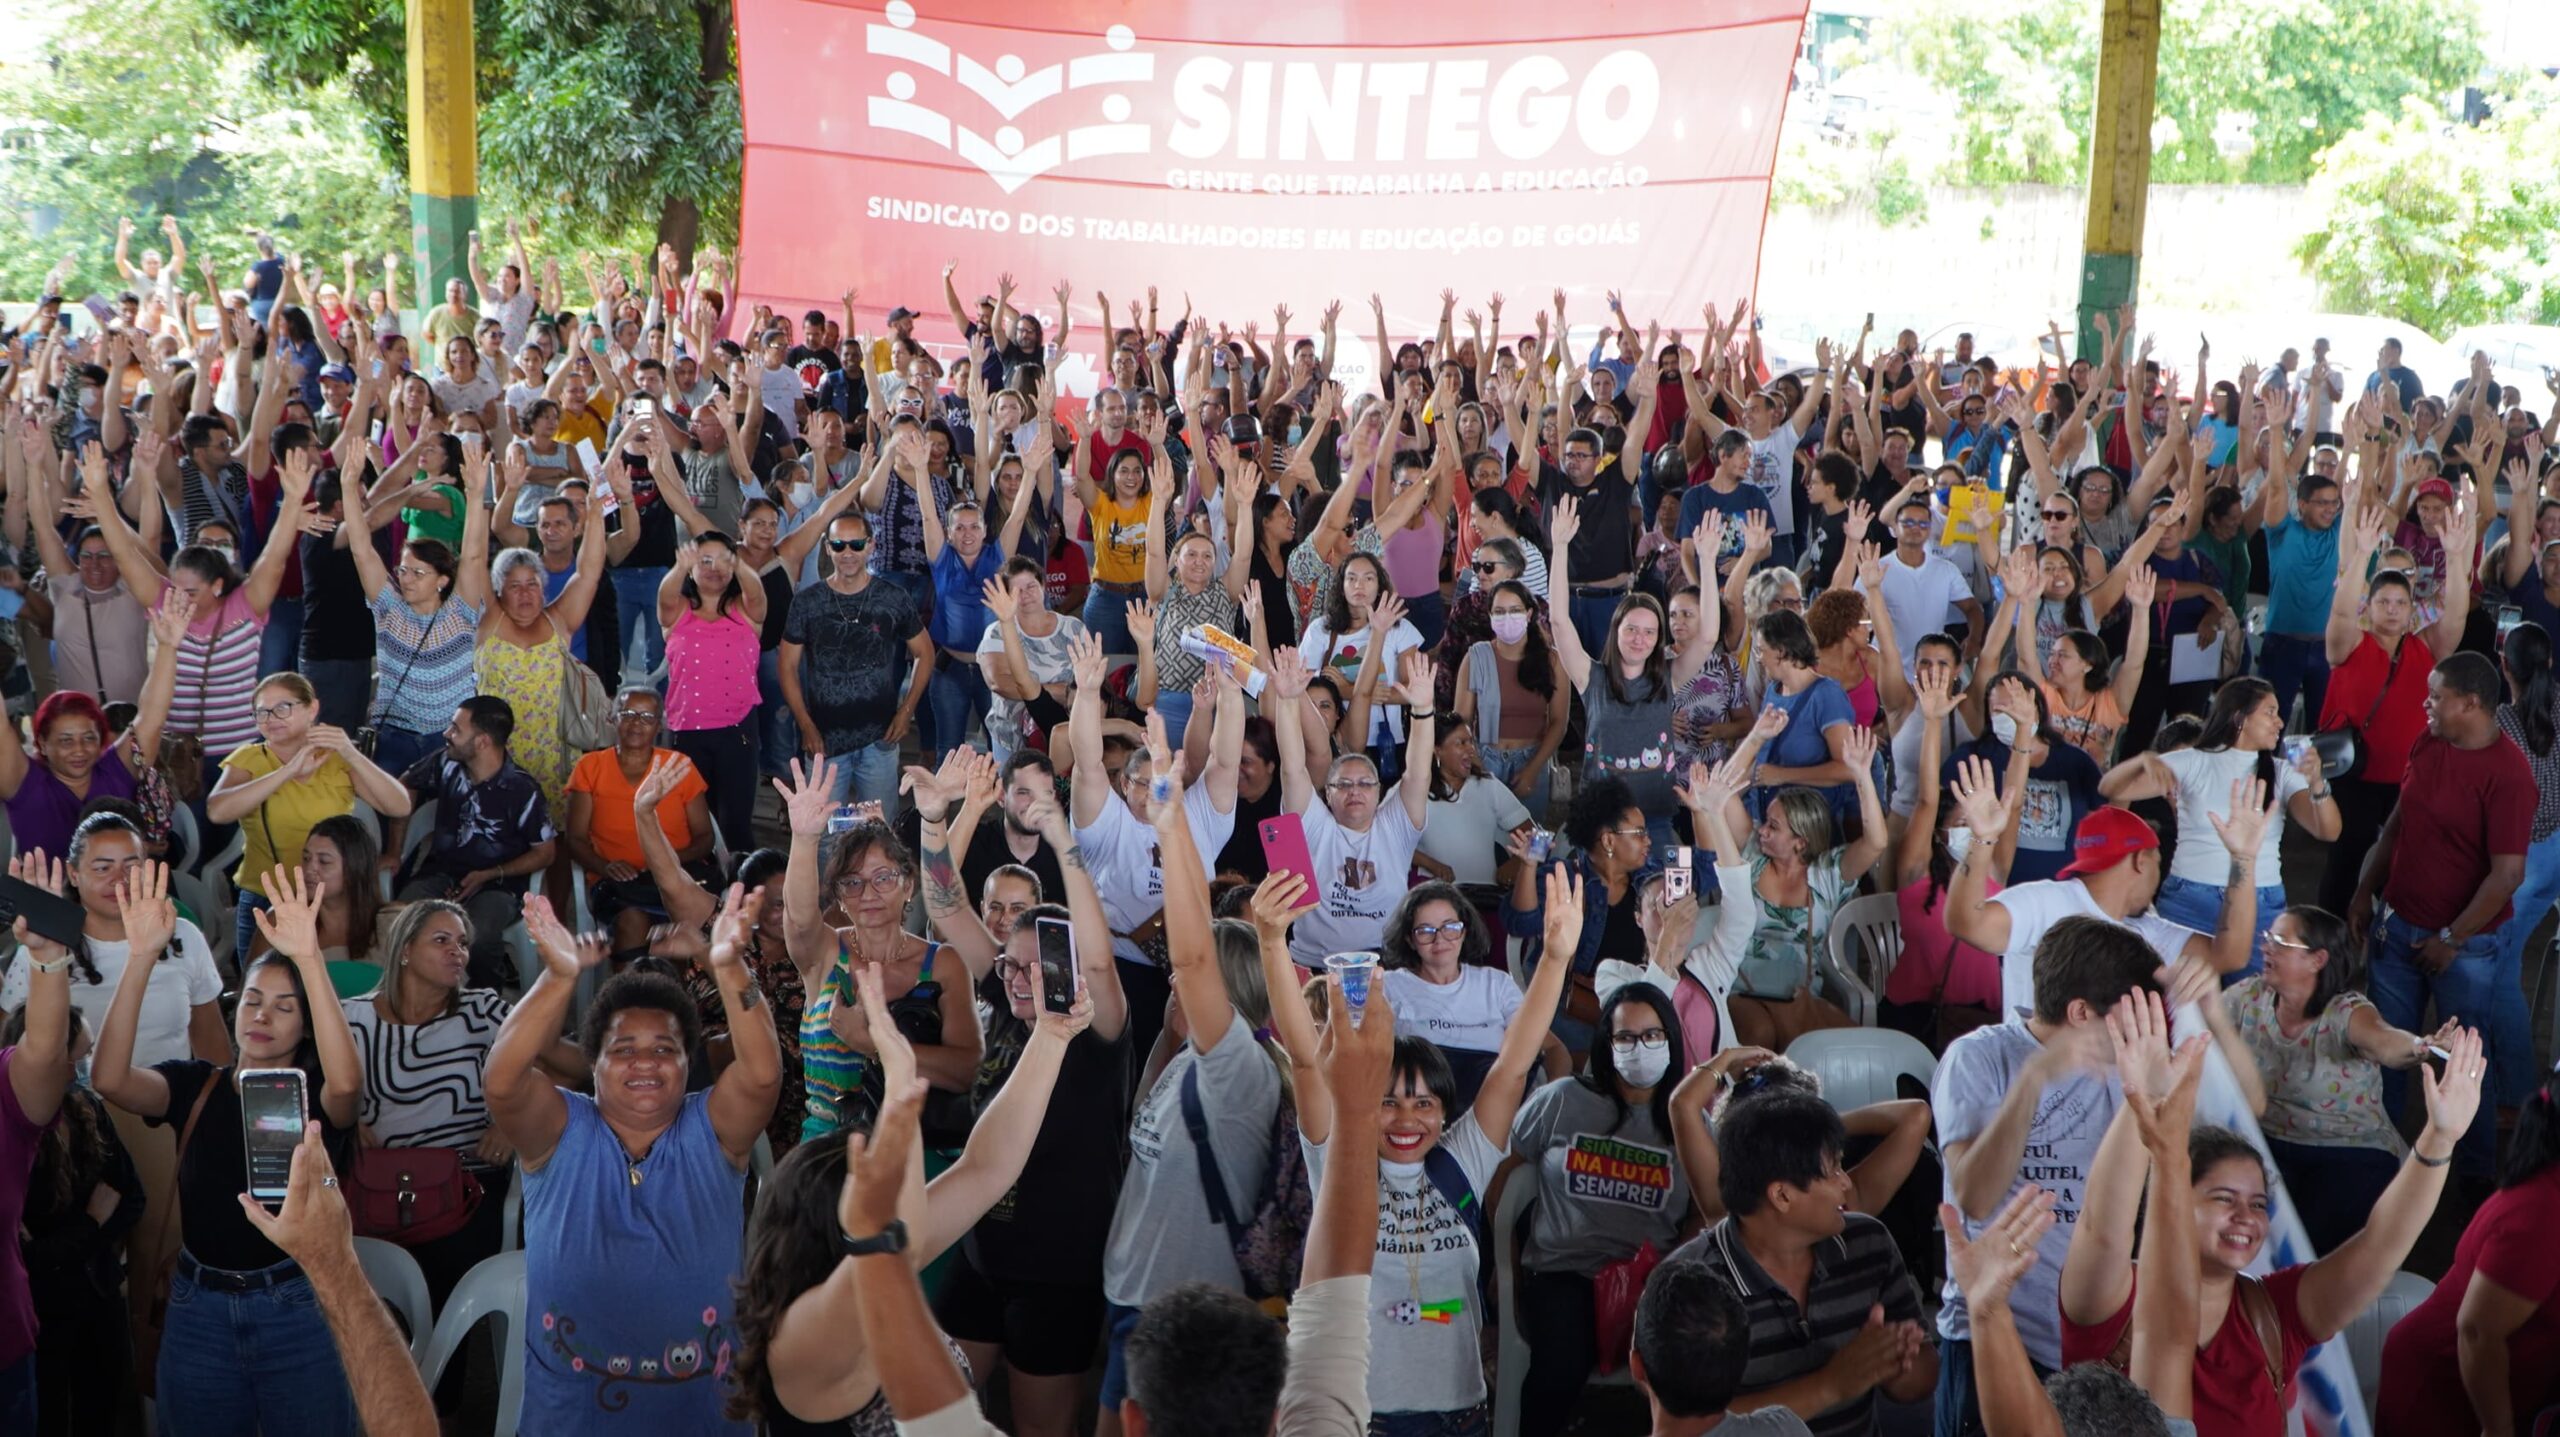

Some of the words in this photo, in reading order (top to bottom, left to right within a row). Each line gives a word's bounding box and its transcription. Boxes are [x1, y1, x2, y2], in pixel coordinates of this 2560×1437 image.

[1167, 49, 1660, 161] SINTEGO
[1166, 167, 1254, 192] GENTE
[1262, 172, 1319, 194] QUE
[1326, 172, 1466, 195] TRABALHA
[1470, 172, 1493, 192] A
[1502, 160, 1649, 194] EDUCAÇÃO
[866, 196, 1011, 232] SINDICATO
[1019, 213, 1075, 238] DOS
[1083, 217, 1306, 250] TRABALHADORES
[1313, 228, 1351, 250] EM
[1359, 219, 1504, 254] EDUCAÇÃO
[1512, 225, 1548, 248] DE
[1553, 216, 1641, 247] GOIÁS
[1583, 1137, 1661, 1166] SINTEGO
[1572, 1151, 1603, 1174] NA
[1610, 1160, 1665, 1186] LUTA
[2023, 1165, 2084, 1182] LUTEI,
[1574, 1174, 1659, 1206] SEMPRE!
[1431, 1234, 1471, 1253] 2023
